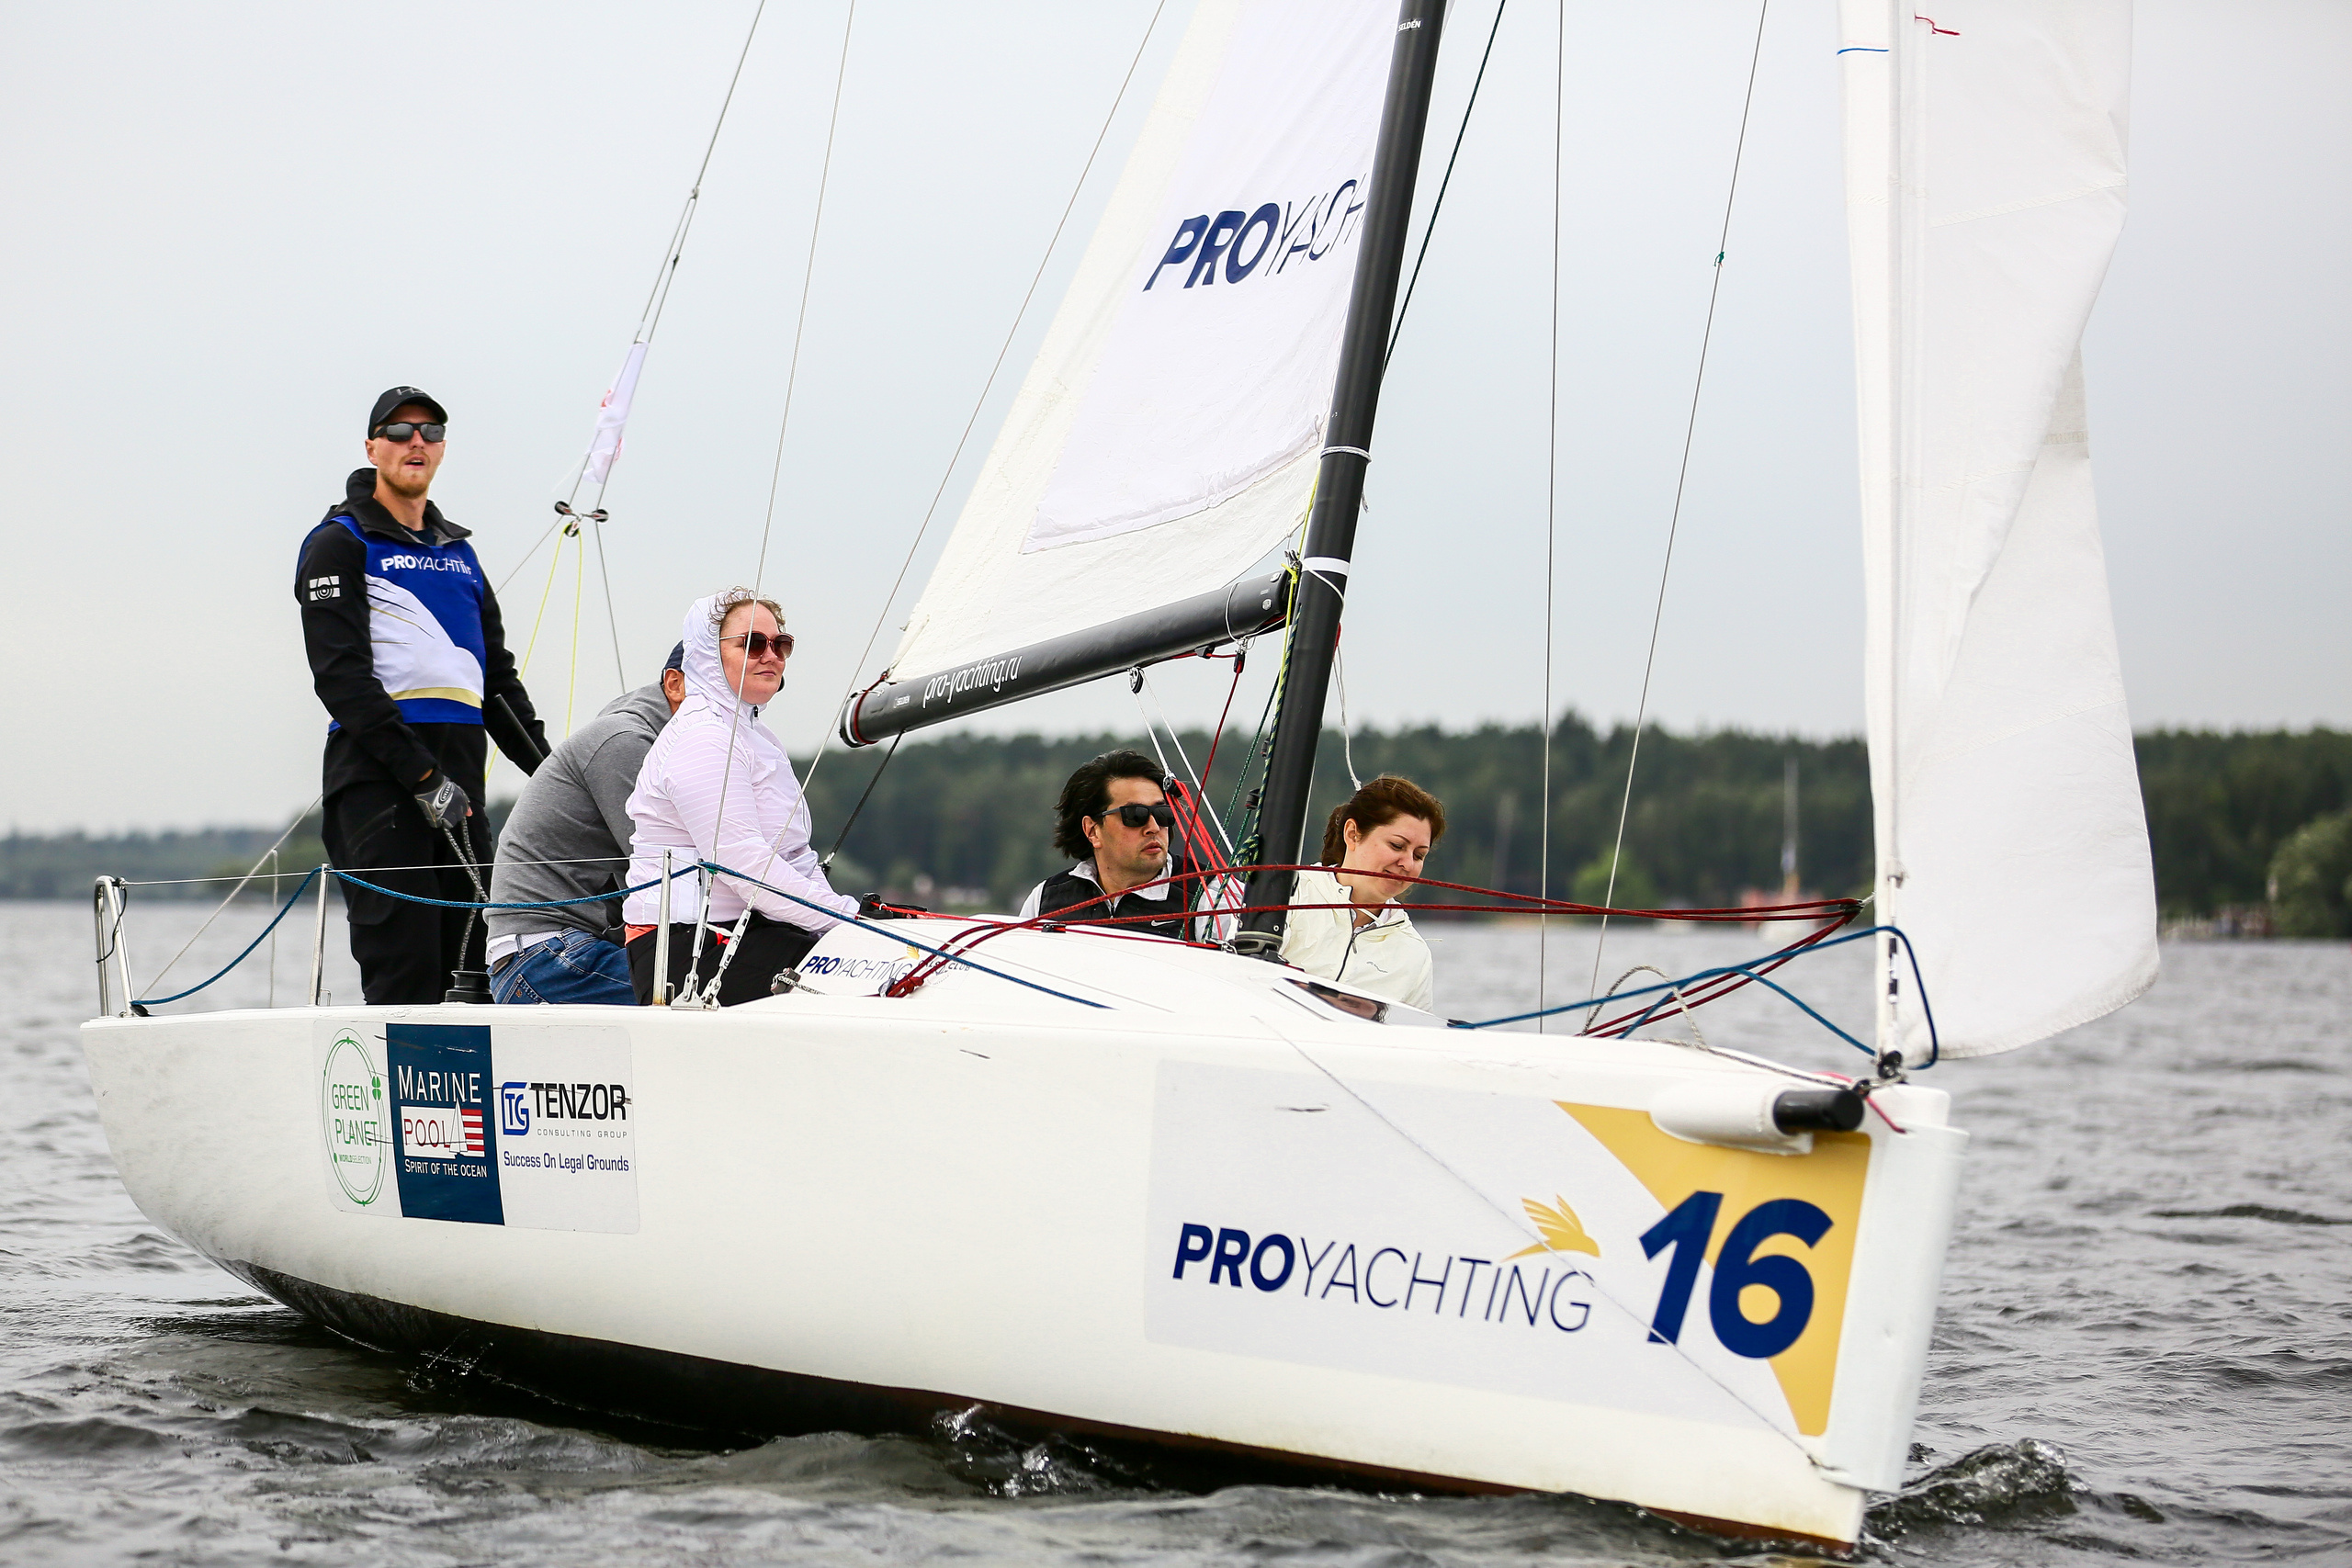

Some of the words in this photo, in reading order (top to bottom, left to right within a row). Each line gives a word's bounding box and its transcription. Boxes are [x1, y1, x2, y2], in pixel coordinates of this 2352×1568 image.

[1142, 173, 1368, 292] PROYACH
[922, 655, 1023, 708] pro-yachting.ru
[800, 955, 913, 981] PROYACHTING
[332, 1084, 369, 1111] GREEN
[397, 1065, 482, 1103] MARINE
[530, 1083, 627, 1121] TENZOR
[334, 1118, 378, 1146] PLANET
[403, 1118, 450, 1148] POOL
[537, 1128, 592, 1138] CONSULTING
[597, 1130, 628, 1139] GROUP
[431, 1161, 440, 1175] OF
[442, 1162, 458, 1177] THE
[460, 1165, 488, 1179] OCEAN
[503, 1150, 541, 1168] Success
[543, 1152, 557, 1168] On
[559, 1153, 584, 1174] Legal
[587, 1154, 629, 1172] Grounds
[1172, 1222, 1595, 1333] PROYACHTING
[1638, 1190, 1834, 1359] 16
